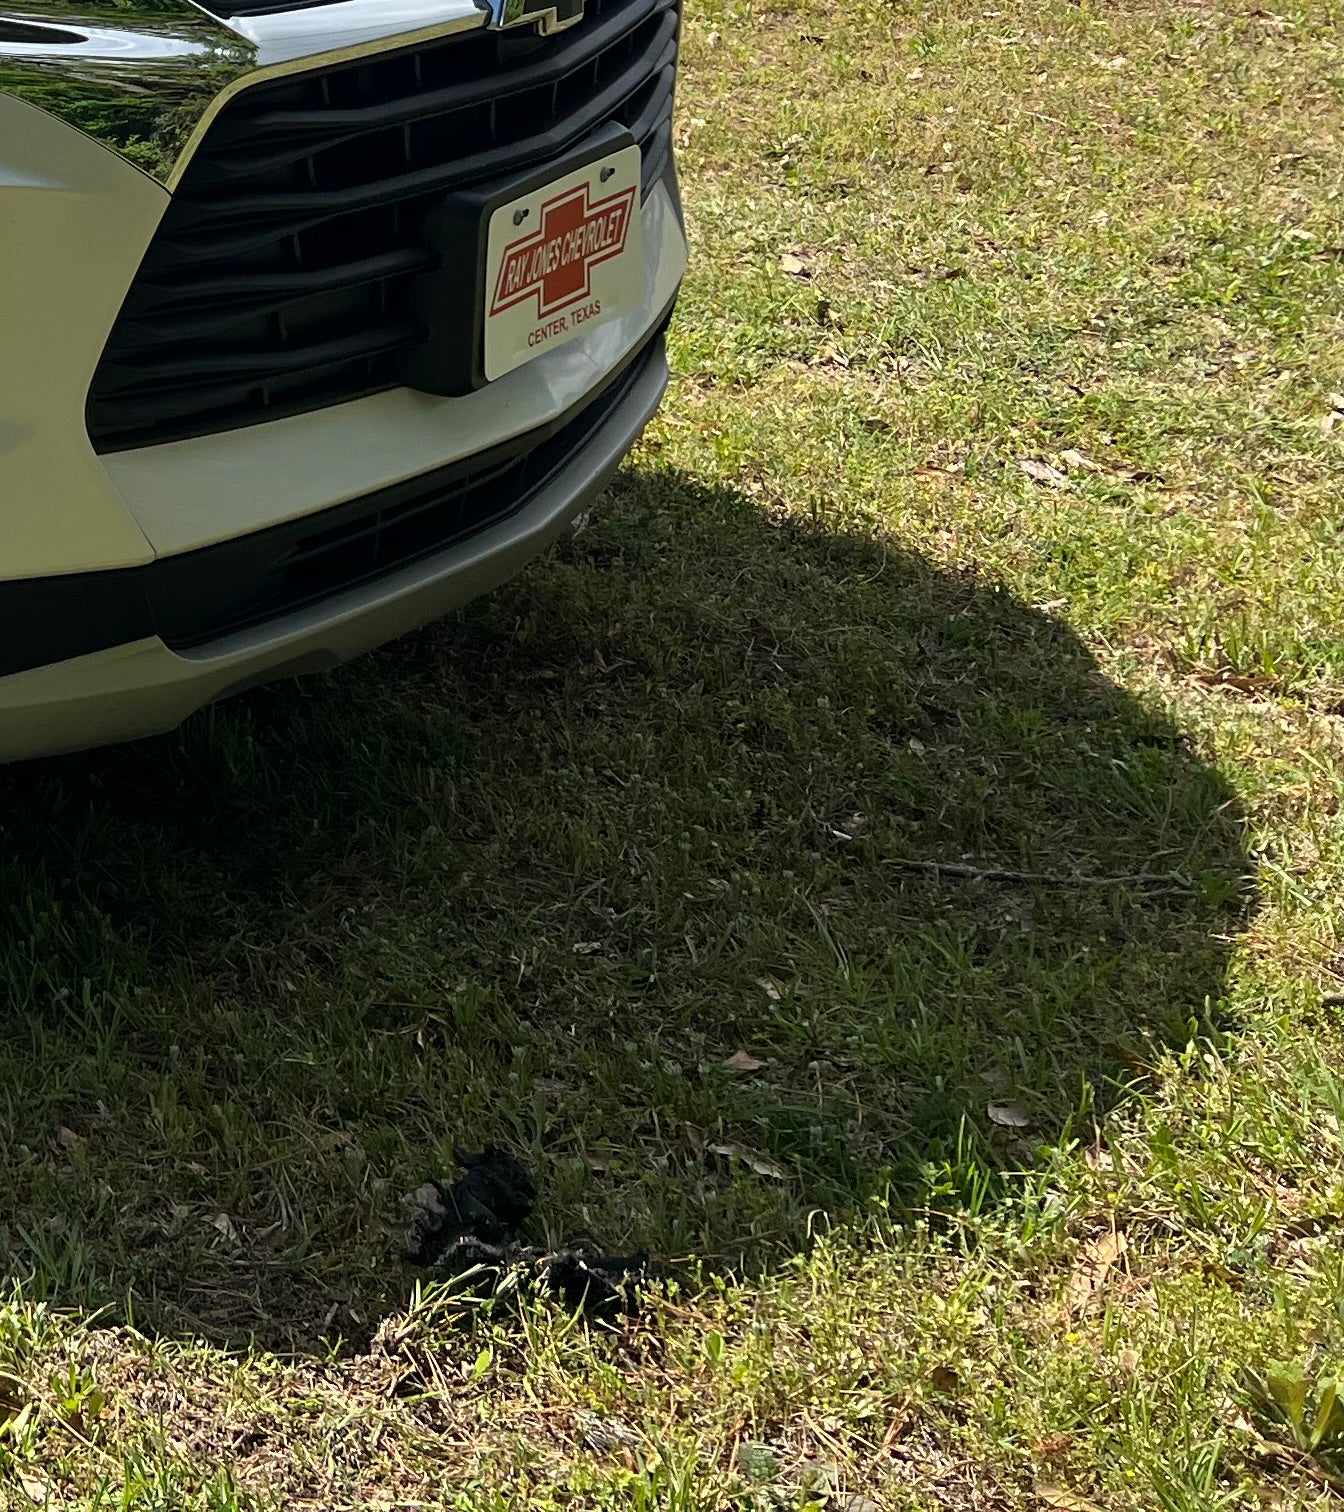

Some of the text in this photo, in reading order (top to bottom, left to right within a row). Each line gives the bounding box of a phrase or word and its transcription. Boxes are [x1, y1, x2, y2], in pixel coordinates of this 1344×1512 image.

[505, 208, 623, 295] RAY JONES CHEVROLET
[527, 300, 601, 347] CENTER, TEXAS
